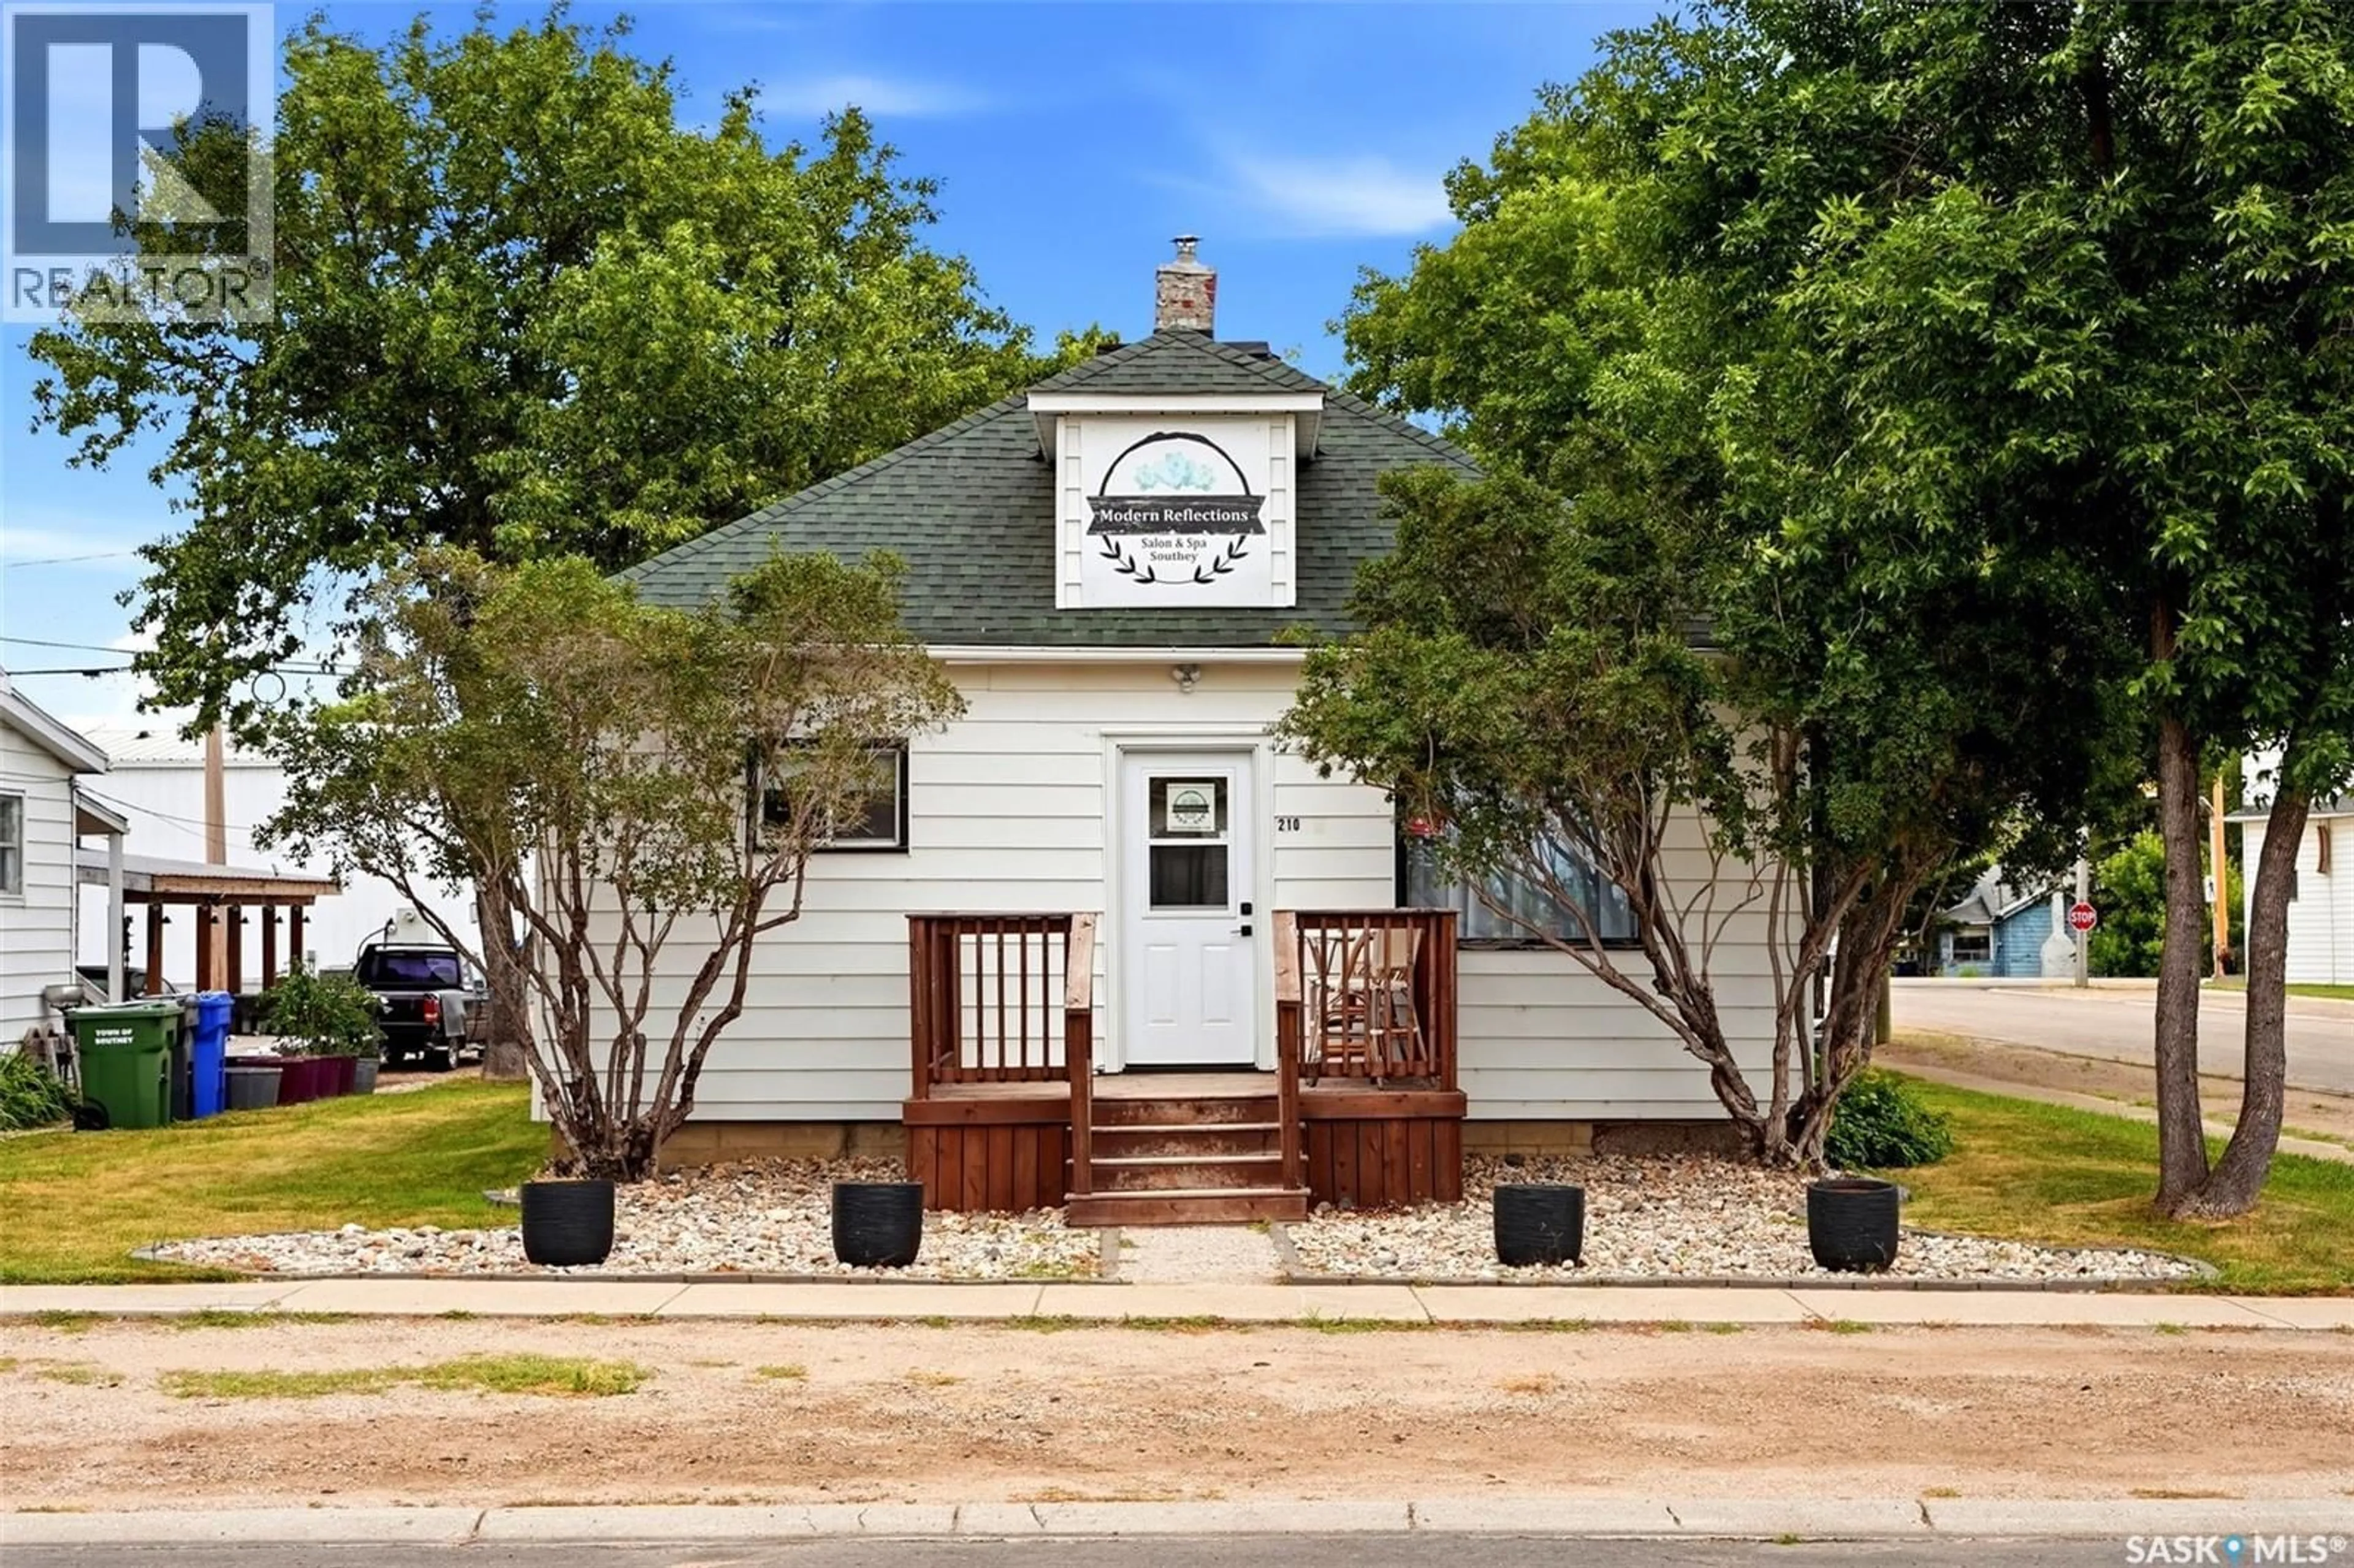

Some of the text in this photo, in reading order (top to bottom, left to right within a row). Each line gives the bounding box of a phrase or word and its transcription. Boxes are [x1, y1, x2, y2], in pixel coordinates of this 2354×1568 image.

[1100, 508, 1249, 522] Modern Reflections
[1141, 537, 1207, 551] Salon & Spa
[1150, 551, 1198, 563] Southey
[1278, 818, 1300, 831] 210
[2071, 911, 2095, 923] STOP
